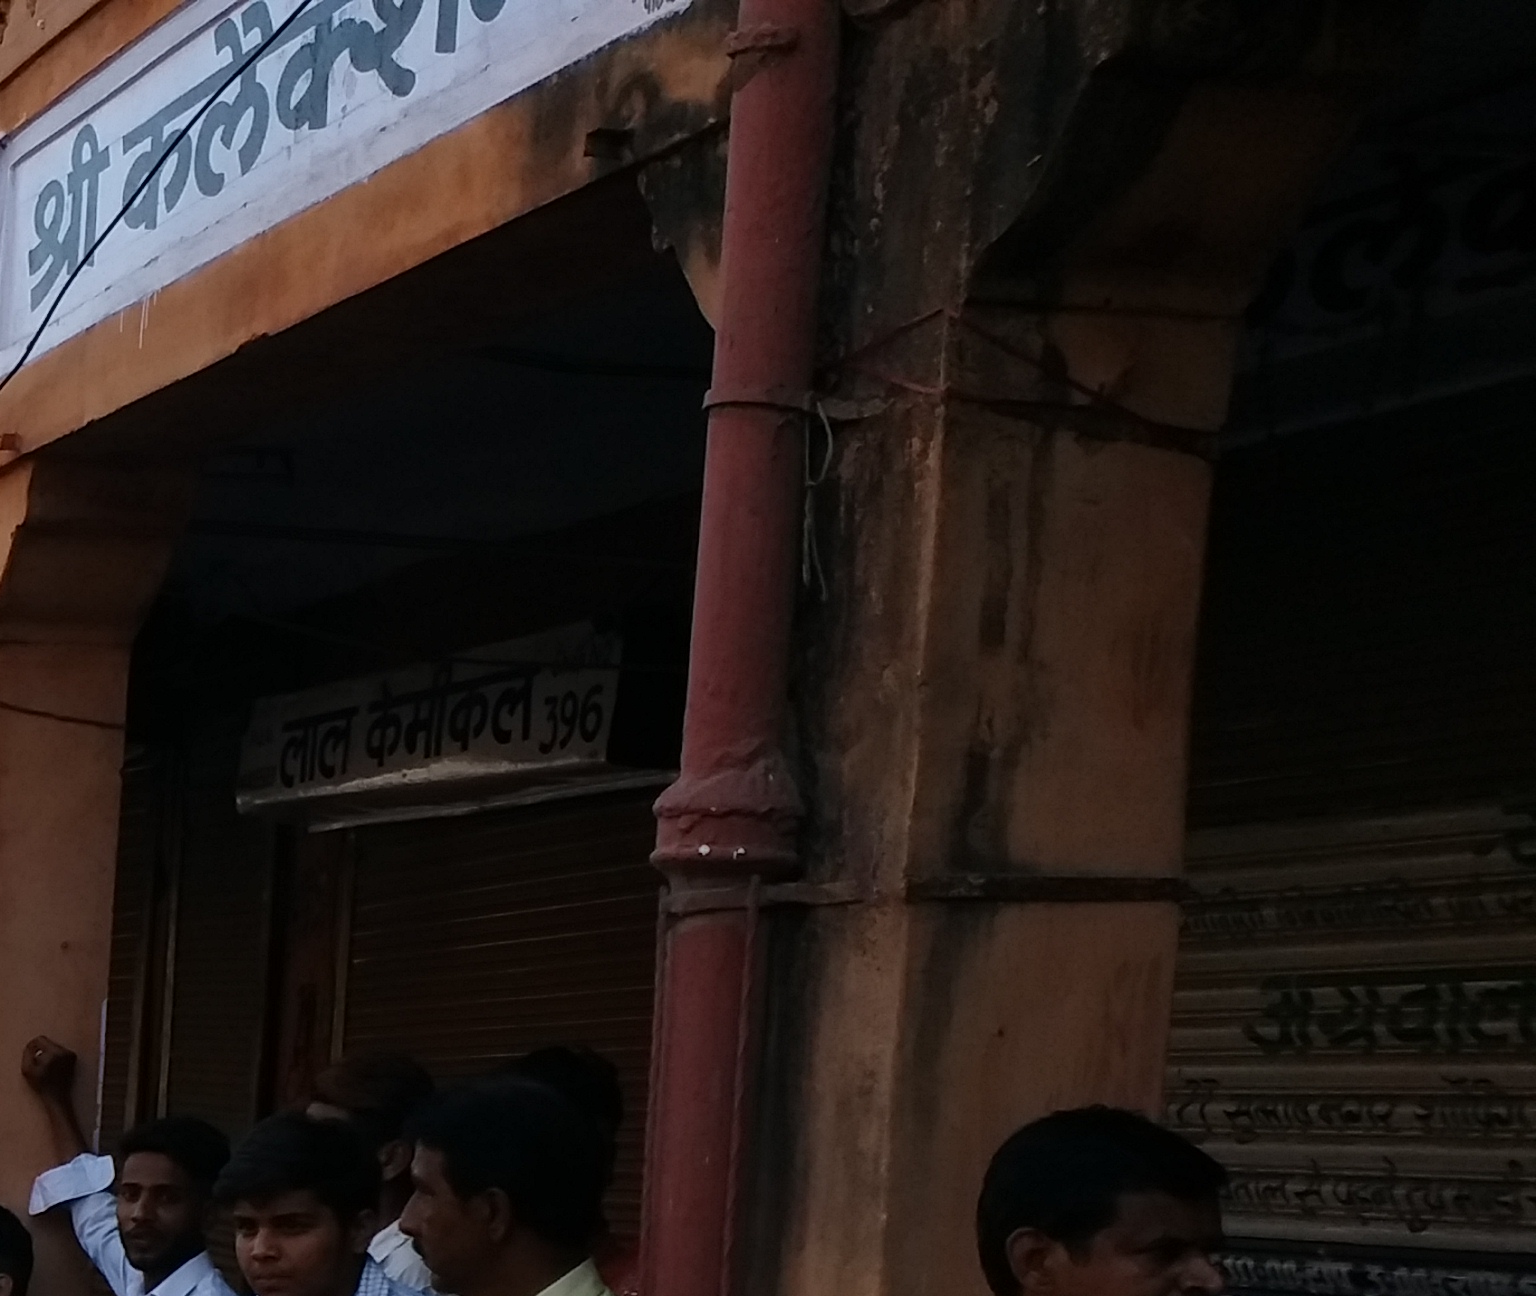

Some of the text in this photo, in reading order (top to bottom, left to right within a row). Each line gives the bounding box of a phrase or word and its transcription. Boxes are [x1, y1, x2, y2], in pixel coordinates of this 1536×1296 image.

[28, 123, 111, 312] श्री
[278, 705, 360, 788] लाल
[538, 683, 604, 756] 396
